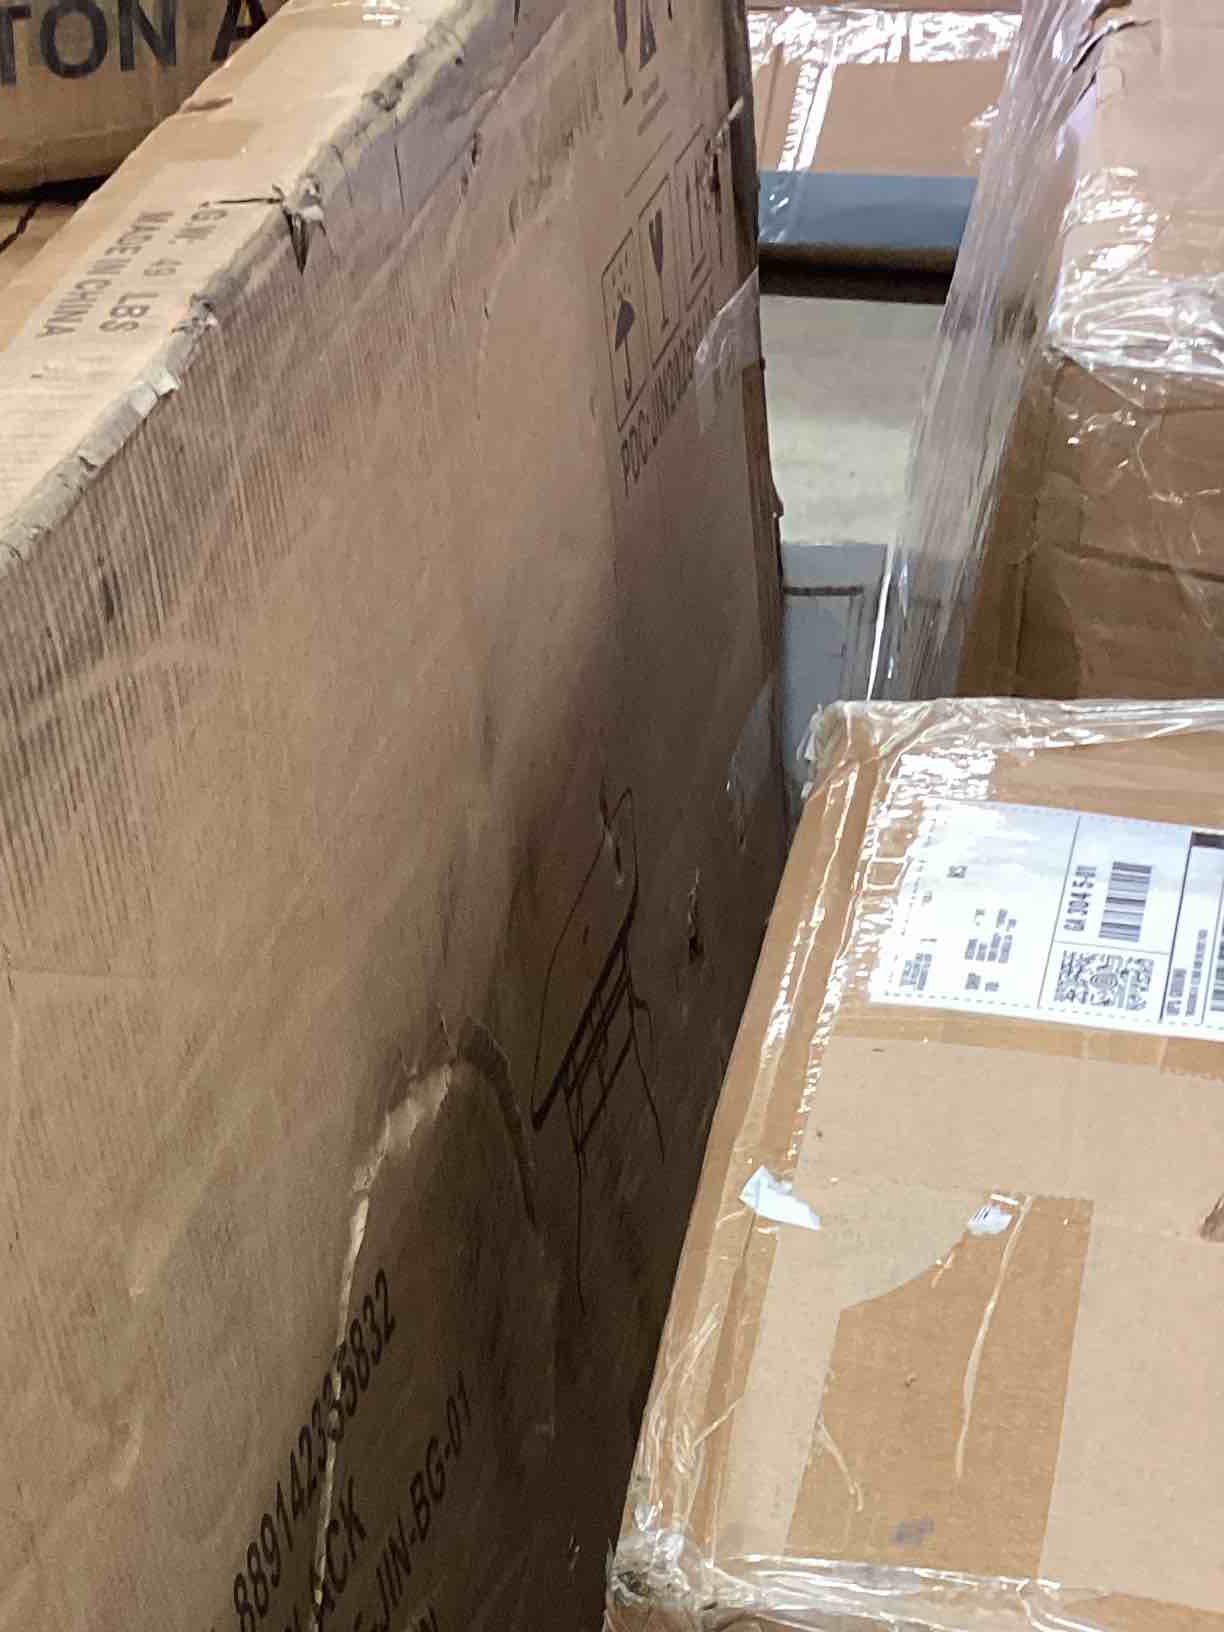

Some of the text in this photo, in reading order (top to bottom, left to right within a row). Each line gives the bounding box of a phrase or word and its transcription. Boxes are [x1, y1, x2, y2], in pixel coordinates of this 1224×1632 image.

[35, 211, 174, 338] MADE IN CHINA
[98, 291, 160, 332] LBS
